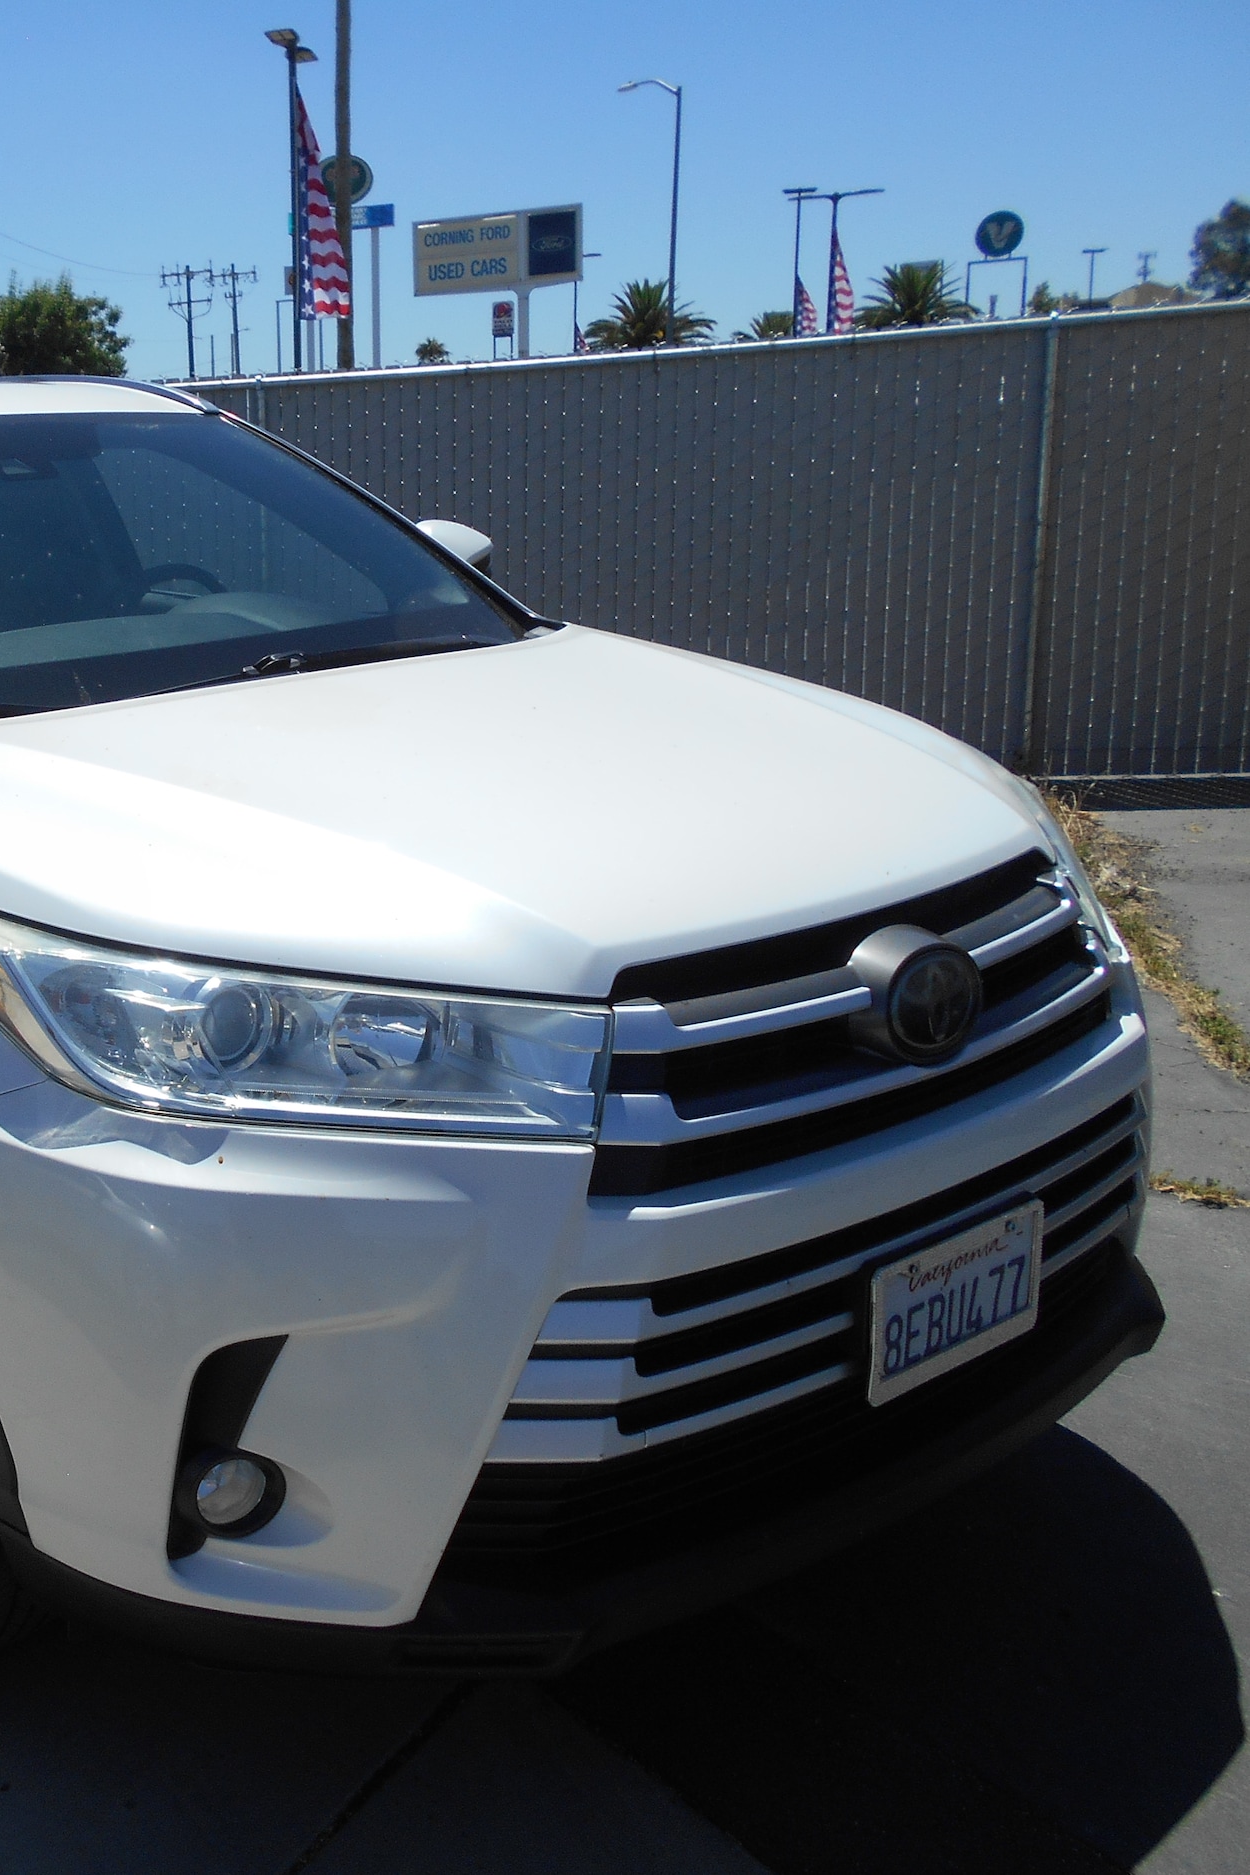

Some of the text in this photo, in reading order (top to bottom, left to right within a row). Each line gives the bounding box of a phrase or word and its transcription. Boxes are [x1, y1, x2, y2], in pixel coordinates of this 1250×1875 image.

[424, 225, 510, 247] CORNING FORD
[428, 257, 507, 281] USED CARS
[883, 1254, 1026, 1376] 8EBU477
